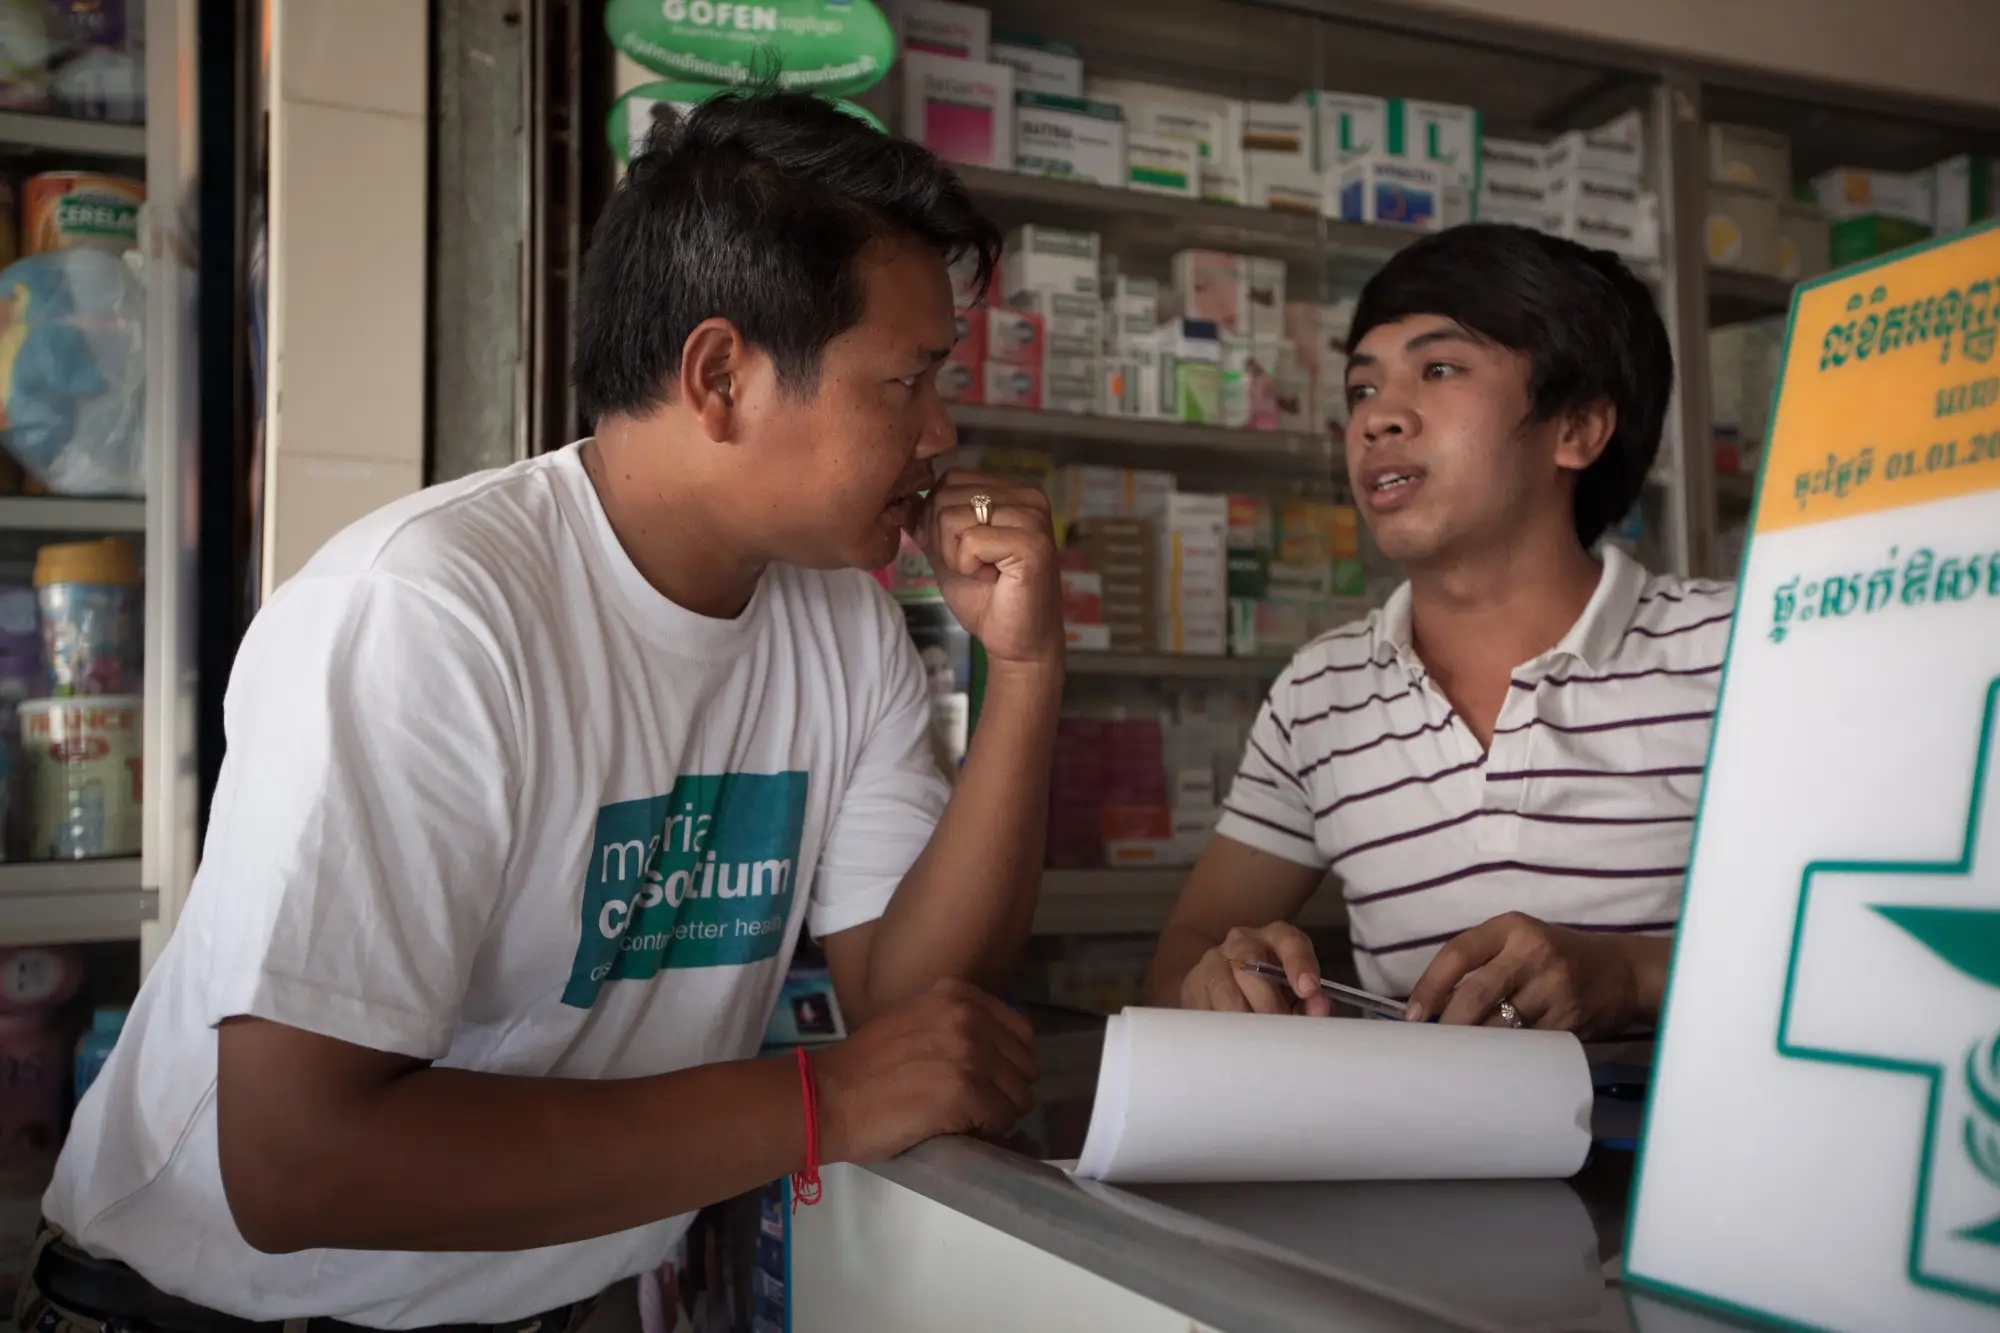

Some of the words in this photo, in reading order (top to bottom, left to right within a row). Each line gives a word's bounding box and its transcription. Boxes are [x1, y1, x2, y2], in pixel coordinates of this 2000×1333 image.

[662, 0, 778, 31] GOFEN
[57, 203, 137, 230] CERELA
[671, 919, 729, 940] etter
